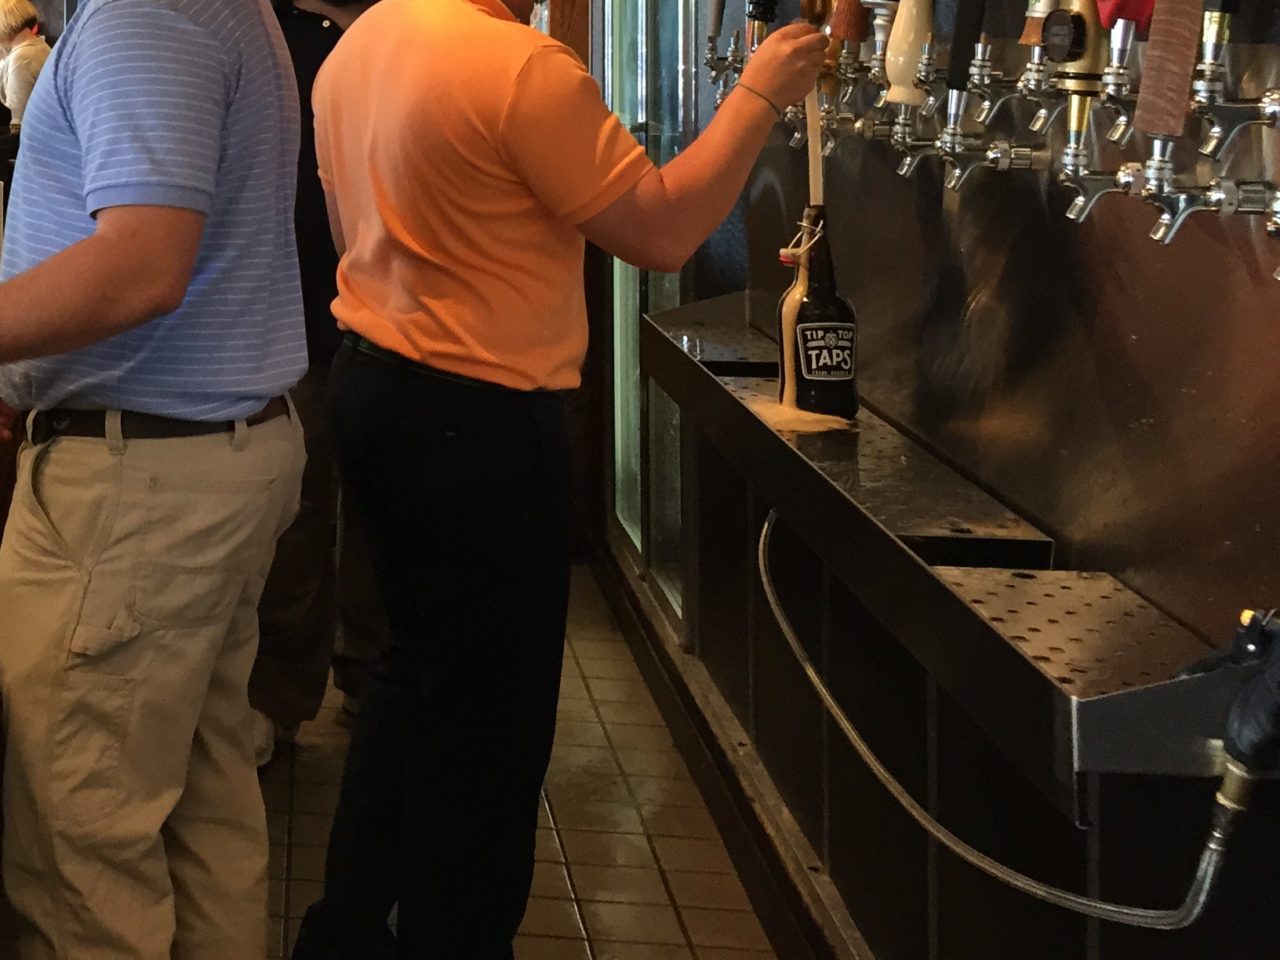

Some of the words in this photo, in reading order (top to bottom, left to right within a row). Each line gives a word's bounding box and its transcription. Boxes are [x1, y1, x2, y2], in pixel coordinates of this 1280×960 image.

[804, 330, 824, 340] TIP
[837, 330, 853, 340] TOP
[808, 349, 851, 370] TAPS
